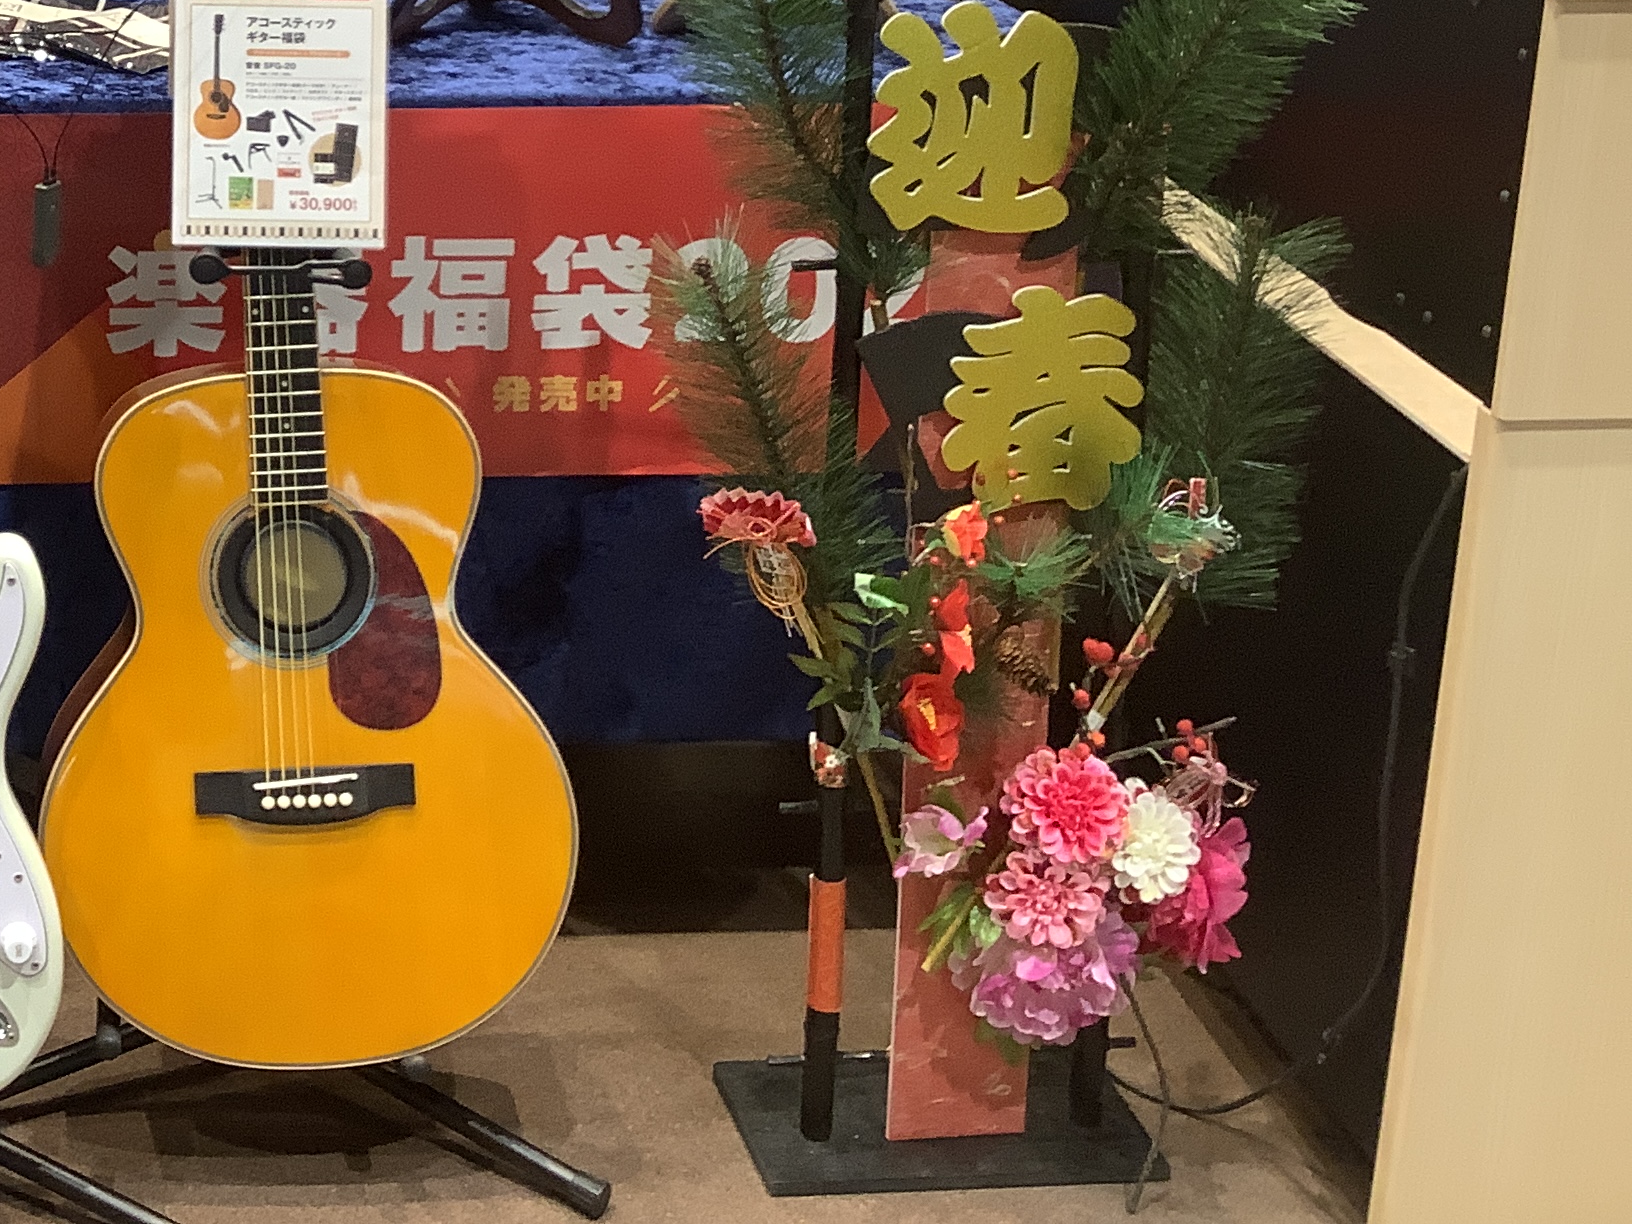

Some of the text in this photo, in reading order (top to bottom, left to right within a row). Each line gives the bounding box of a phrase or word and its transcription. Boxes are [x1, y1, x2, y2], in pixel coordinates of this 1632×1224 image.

[245, 16, 336, 30] アコースティック
[245, 31, 306, 44] ギター福袋
[288, 196, 353, 212] ¥30,900
[492, 375, 623, 413] 発売中
